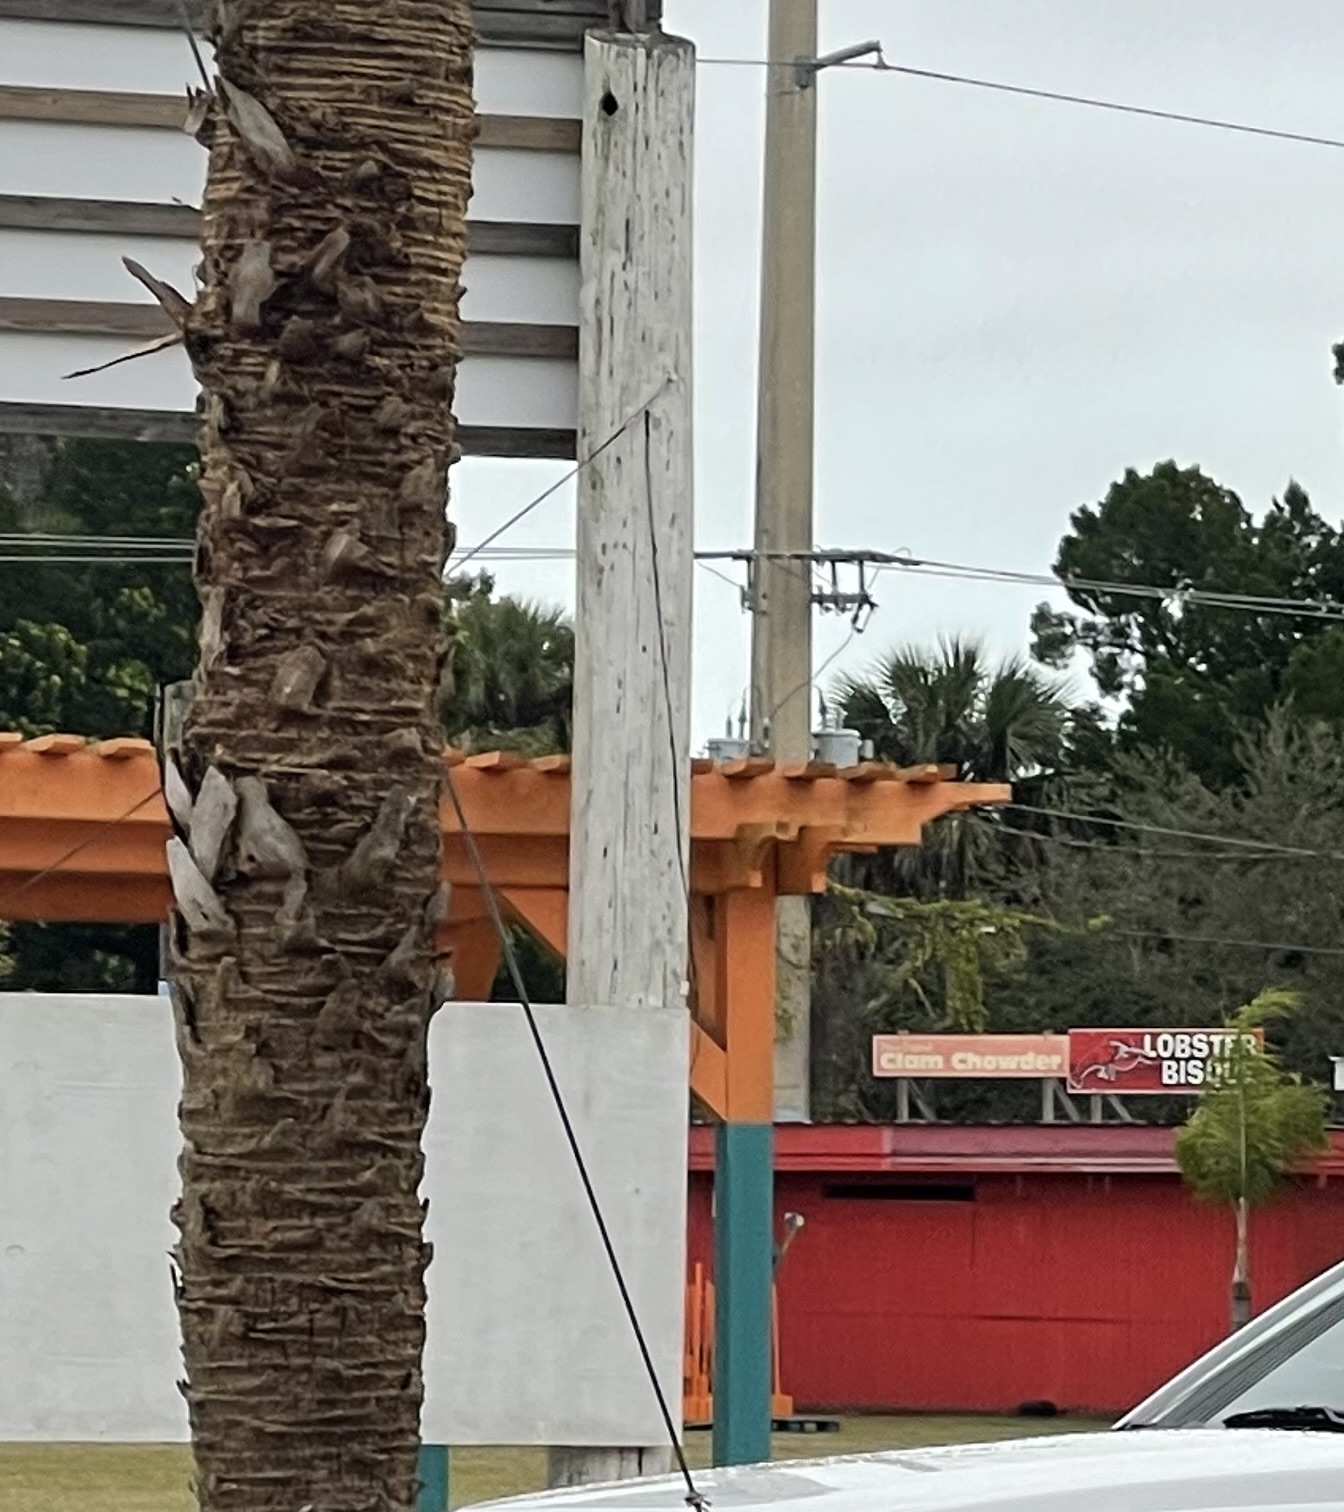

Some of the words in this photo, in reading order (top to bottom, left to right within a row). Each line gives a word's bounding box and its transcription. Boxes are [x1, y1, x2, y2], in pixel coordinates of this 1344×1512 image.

[1143, 1033, 1258, 1058] LOBSTER
[879, 1053, 944, 1070] Clam
[951, 1052, 1062, 1071] Chowder
